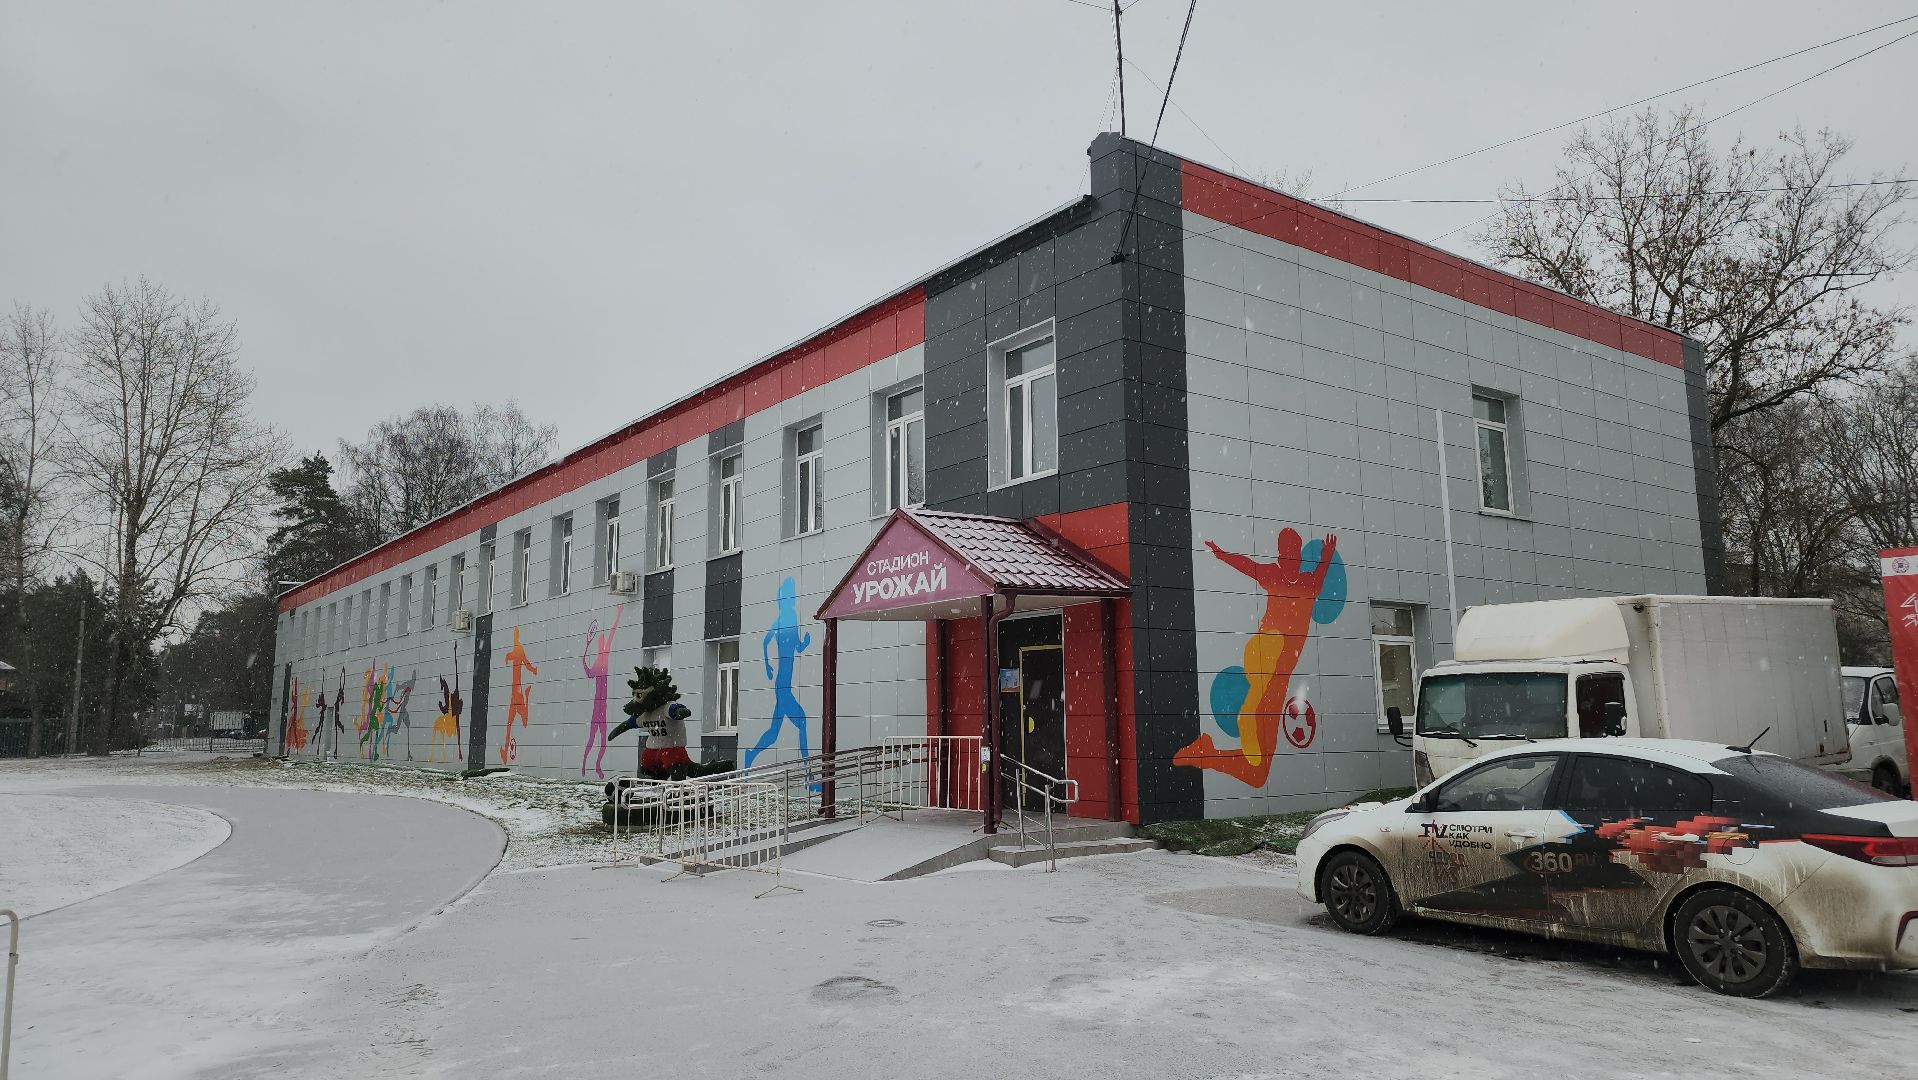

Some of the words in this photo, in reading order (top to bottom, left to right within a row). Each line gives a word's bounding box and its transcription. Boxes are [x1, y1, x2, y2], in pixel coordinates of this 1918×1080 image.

[867, 551, 929, 576] СТАДИОН
[853, 562, 947, 604] УРОЖАЙ
[1421, 823, 1448, 838] TV
[1449, 824, 1493, 833] СМОТРИ
[1449, 832, 1470, 840] КАК
[1449, 840, 1492, 850] УДОБНО
[1530, 851, 1573, 873] 360
